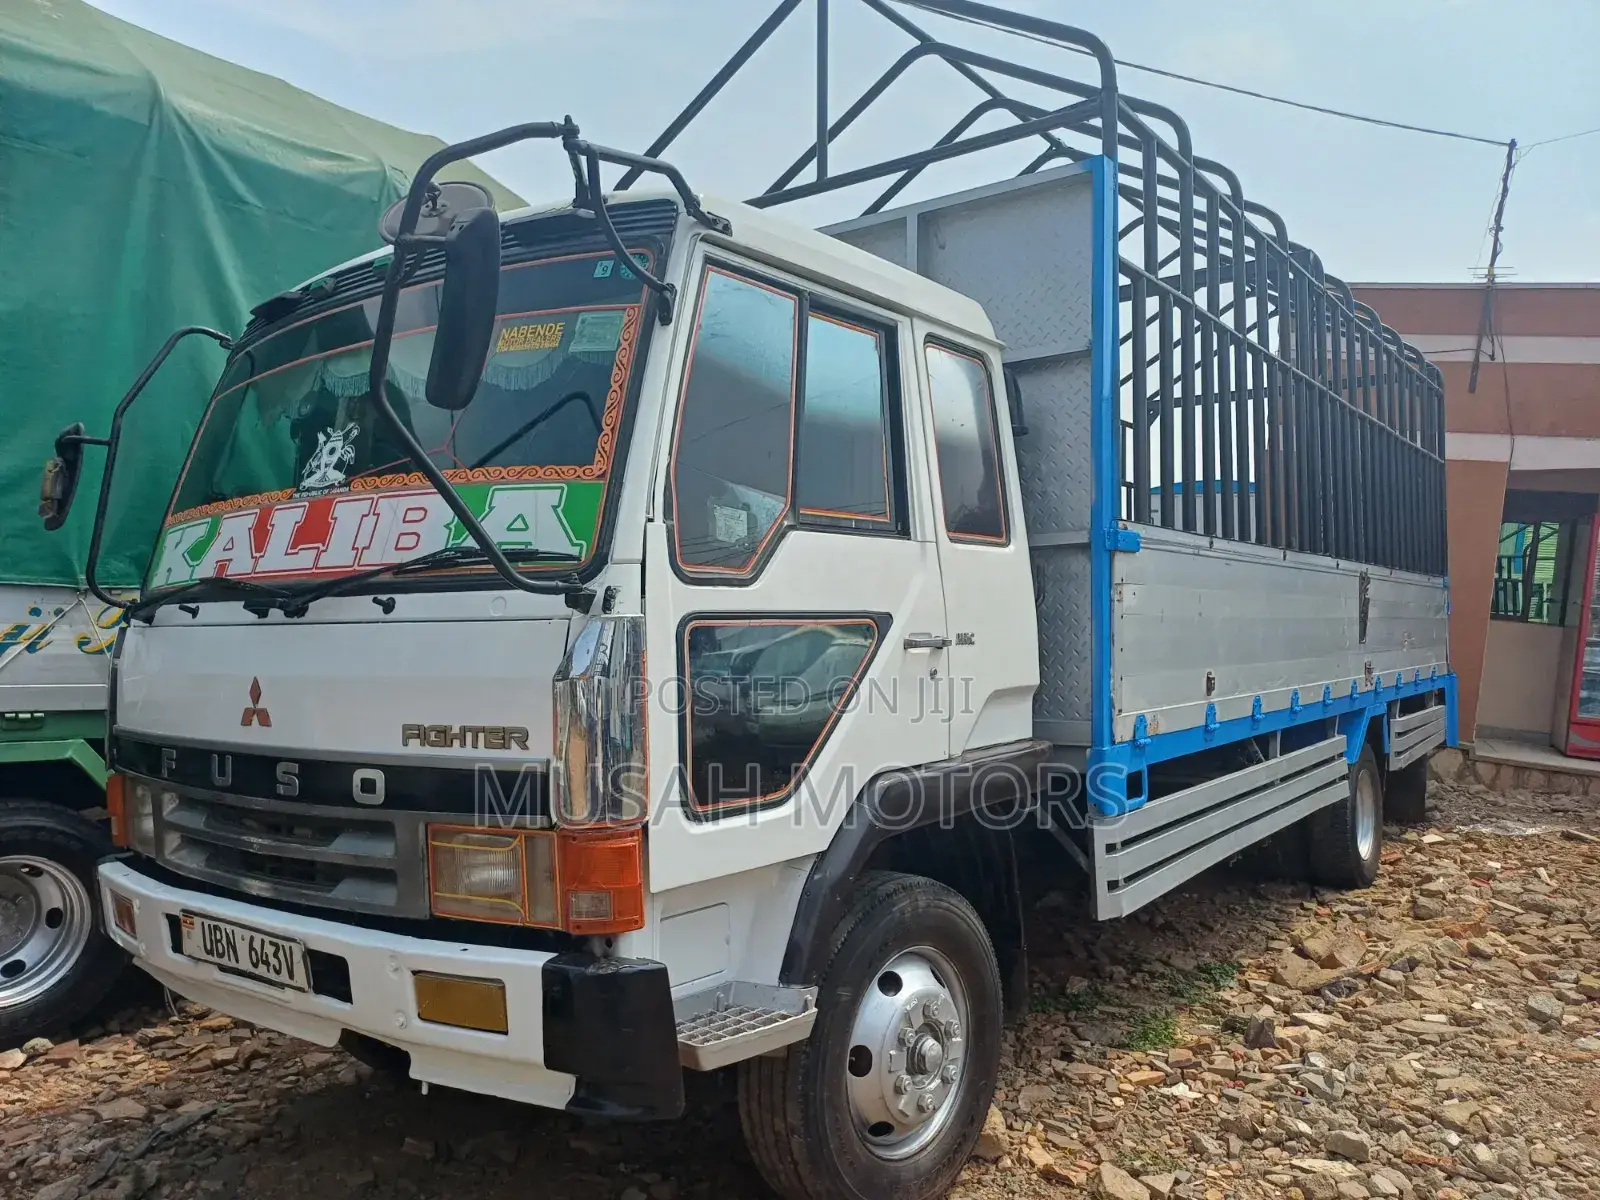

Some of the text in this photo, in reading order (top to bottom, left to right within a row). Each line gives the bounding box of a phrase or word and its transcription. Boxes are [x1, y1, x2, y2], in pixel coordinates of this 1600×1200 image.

[501, 322, 566, 339] NABENDE
[151, 484, 587, 588] KALIBA
[401, 723, 530, 751] FIGHTER
[160, 748, 386, 806] FUSO
[201, 921, 295, 981] UBN 643V
